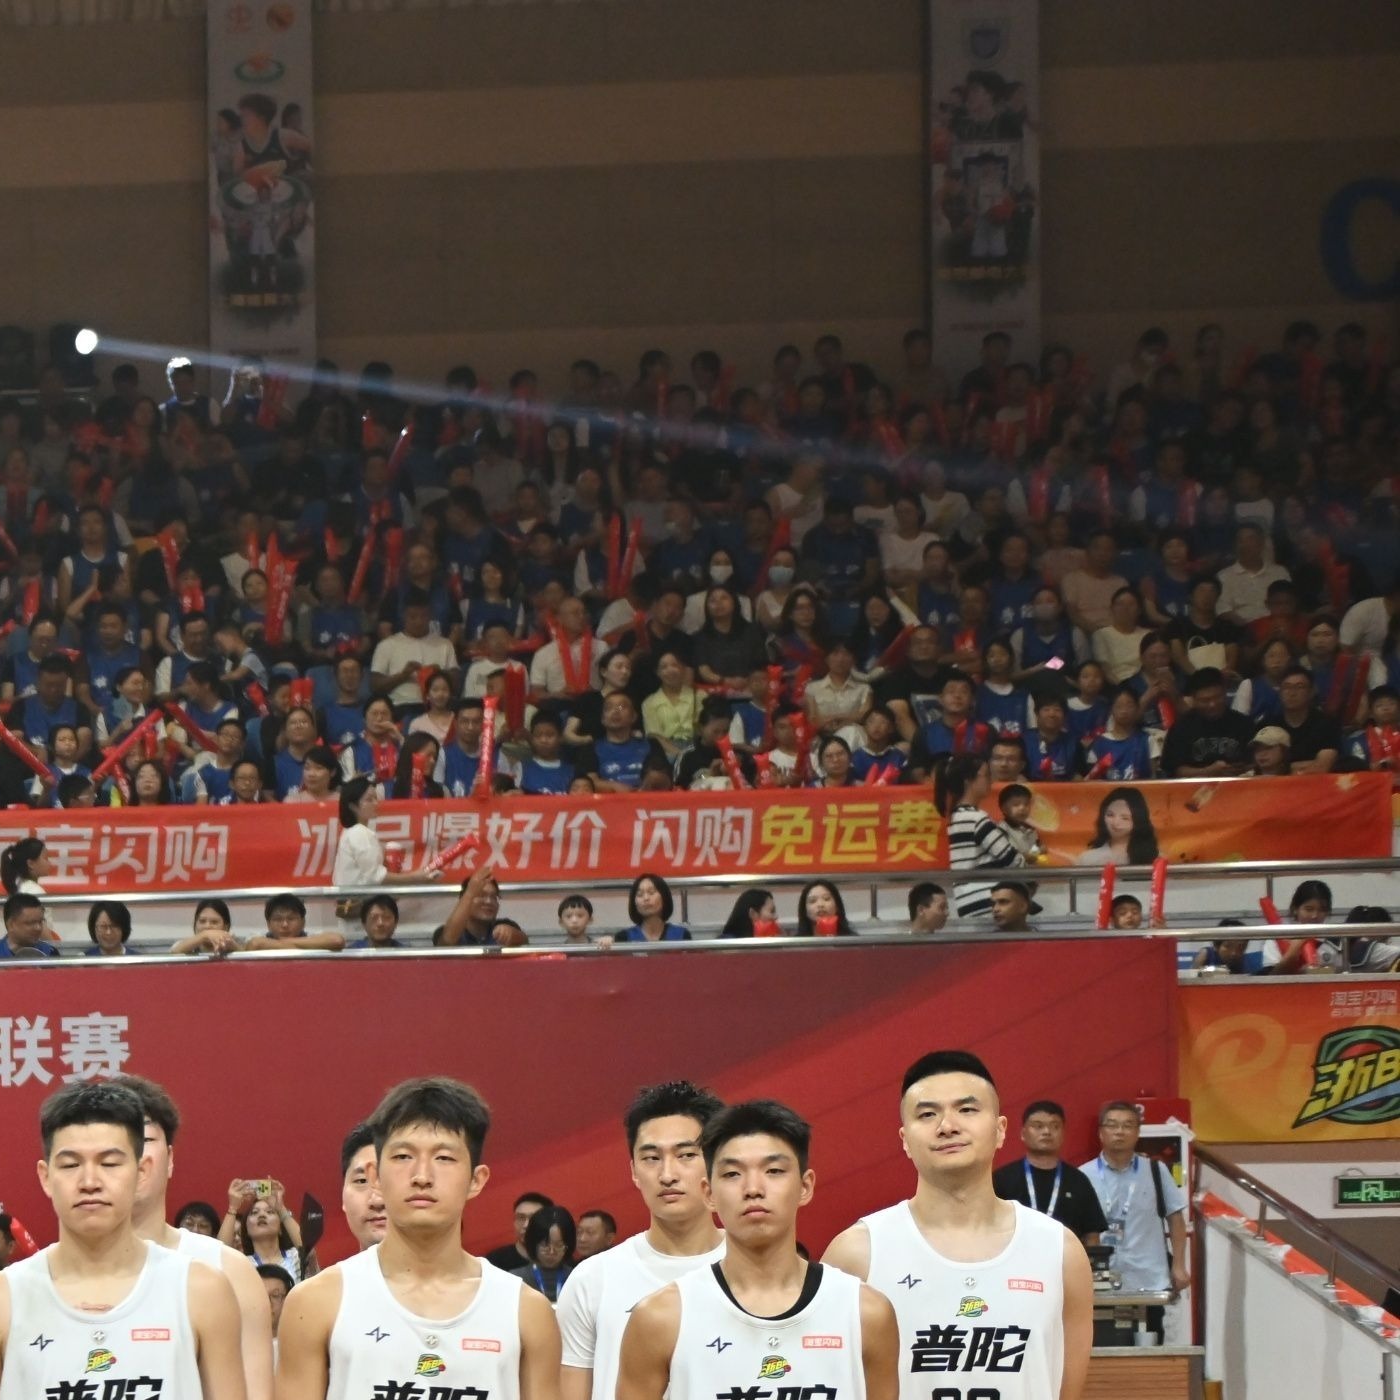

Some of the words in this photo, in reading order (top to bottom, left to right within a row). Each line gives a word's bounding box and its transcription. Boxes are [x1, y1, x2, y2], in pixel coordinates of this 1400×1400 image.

[630, 799, 947, 870] 闪购免运费
[910, 1324, 1031, 1373] 普陀
